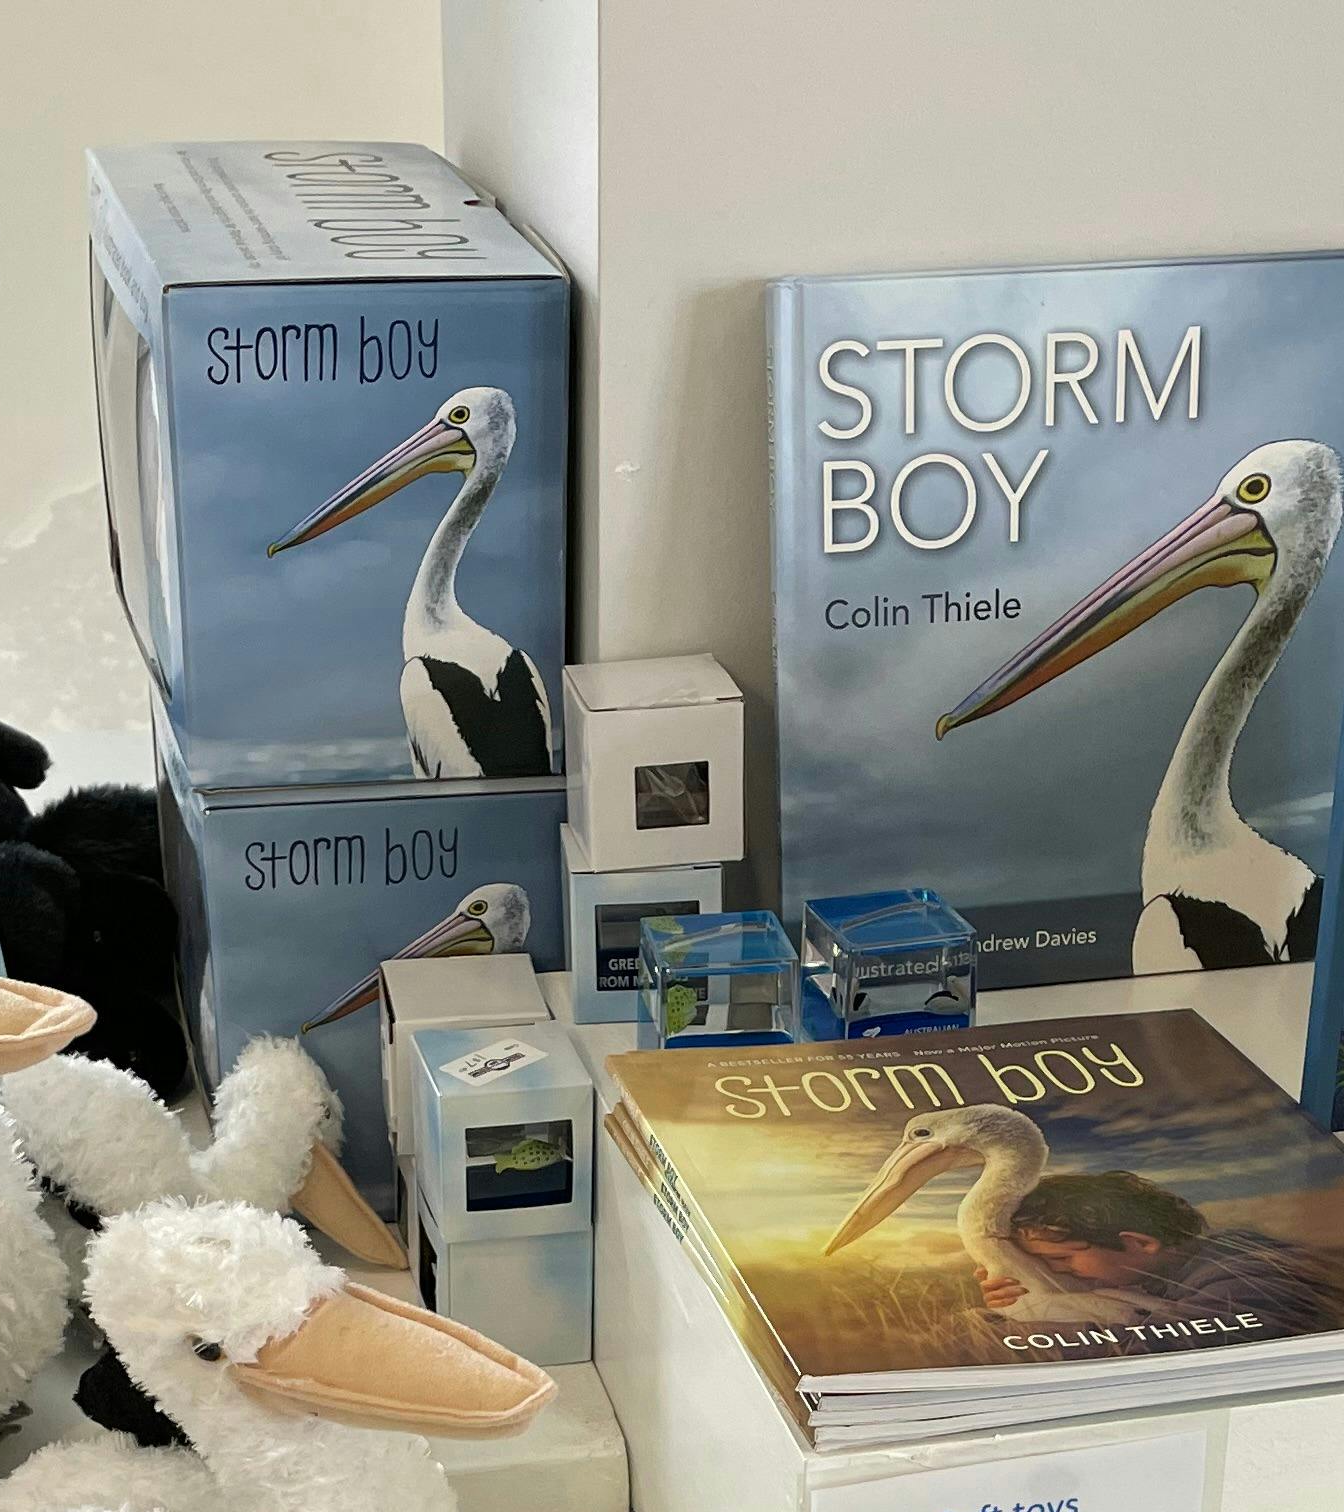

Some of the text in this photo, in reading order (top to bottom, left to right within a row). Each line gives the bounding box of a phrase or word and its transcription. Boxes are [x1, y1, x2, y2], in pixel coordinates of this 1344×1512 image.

[207, 316, 440, 385] storm boy
[818, 325, 1202, 440] STORM
[822, 449, 1049, 554] BOY
[824, 588, 1022, 630] Colin Thiele
[245, 826, 459, 891] storm boy
[976, 933, 1030, 953] ndrew
[1035, 929, 1097, 949] Davies
[599, 975, 630, 988] ROM
[808, 1055, 834, 1063] FOR
[858, 1051, 901, 1060] YEARS
[913, 1049, 943, 1057] Now
[958, 1044, 996, 1053] Major
[1000, 1040, 1048, 1049] Motion
[1050, 1035, 1099, 1044] Picture
[714, 1043, 1144, 1118] storm boy
[1003, 1312, 1264, 1353] COLIN THIELE
